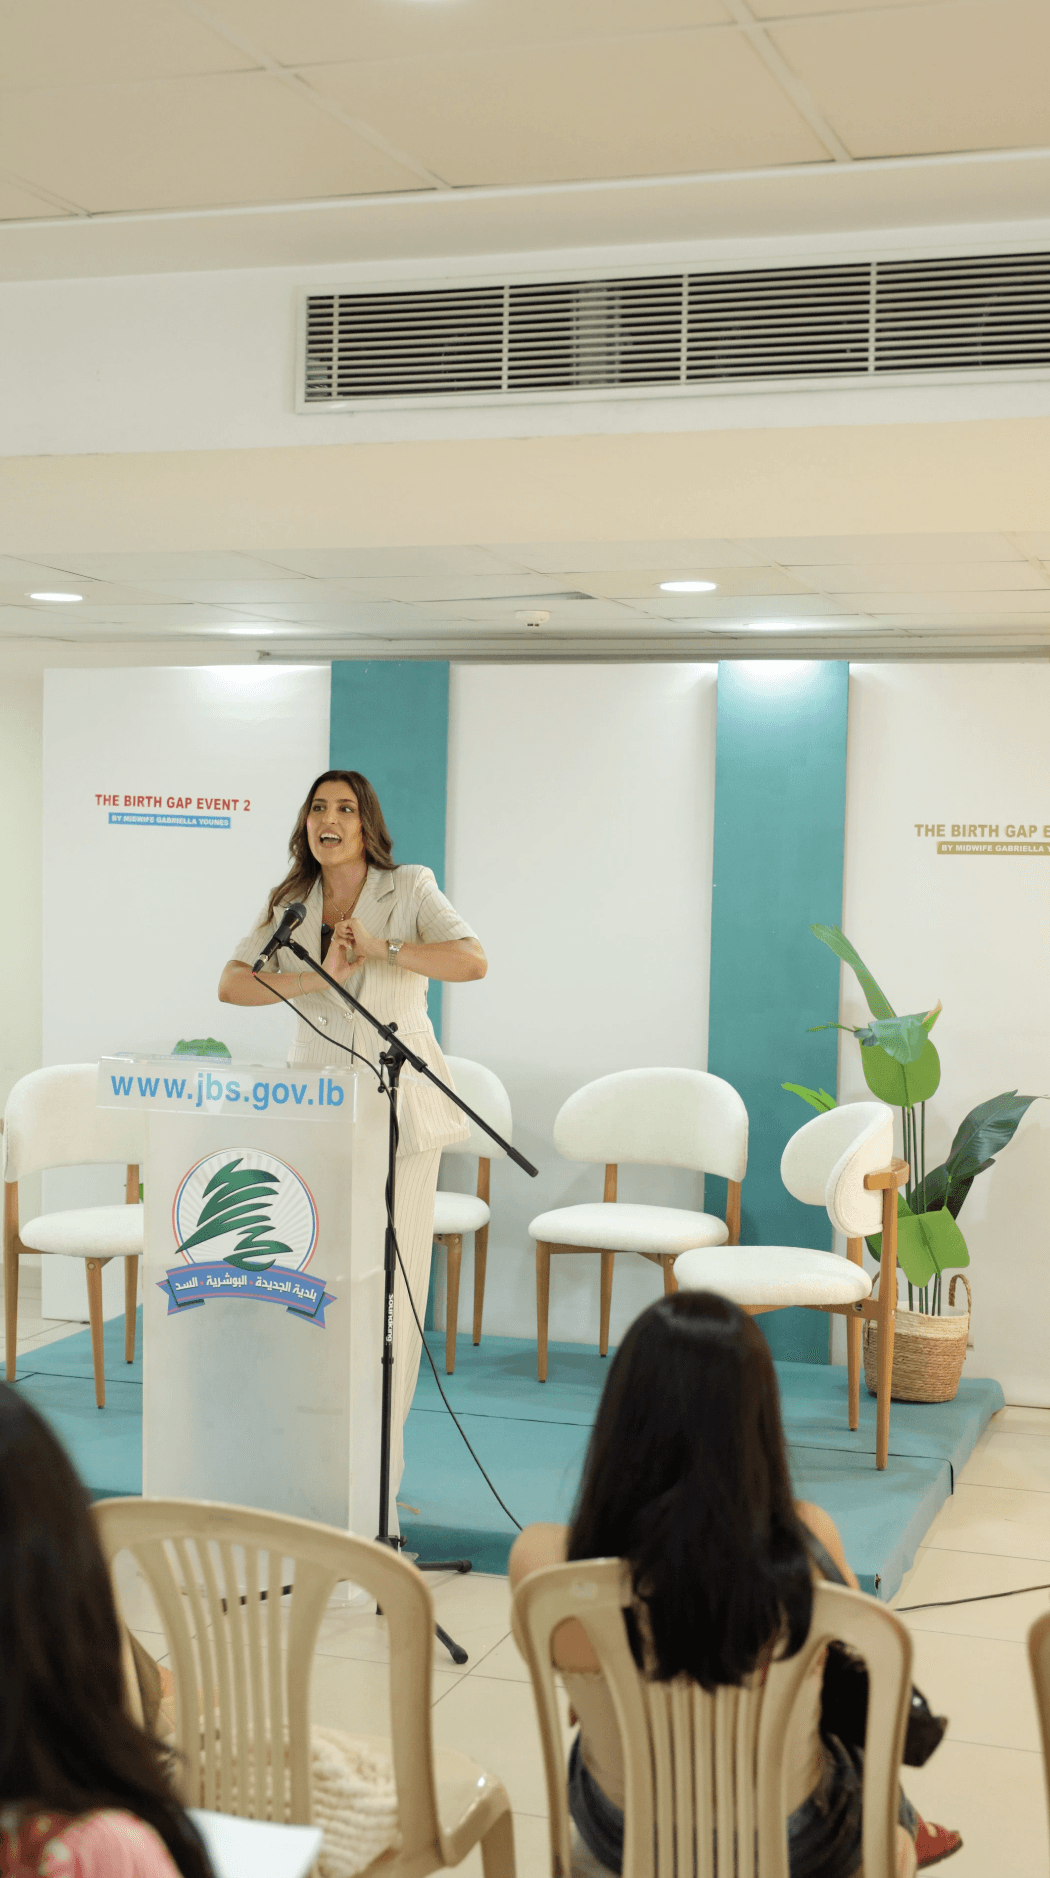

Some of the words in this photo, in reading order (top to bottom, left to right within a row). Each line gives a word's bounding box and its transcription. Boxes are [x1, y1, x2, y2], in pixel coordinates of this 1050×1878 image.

[95, 794, 120, 806] THE
[124, 795, 162, 808] BIRTH
[166, 796, 192, 809] GAP
[196, 798, 239, 811] EVENT
[243, 799, 251, 812] 2
[123, 815, 155, 823] MIDWIFE
[156, 816, 197, 825] GABRIELLA
[198, 818, 229, 826] YOUNES
[914, 824, 946, 837] THE
[951, 824, 999, 838] BIRTH
[1005, 824, 1038, 838] GAP
[955, 844, 993, 852] MIDWIFE
[110, 1072, 344, 1111] www.jbs.gov.lb
[175, 1277, 198, 1291] السد
[206, 1272, 248, 1289] البوشرية
[255, 1276, 291, 1294] الجديدة
[292, 1283, 317, 1303] بلدية
